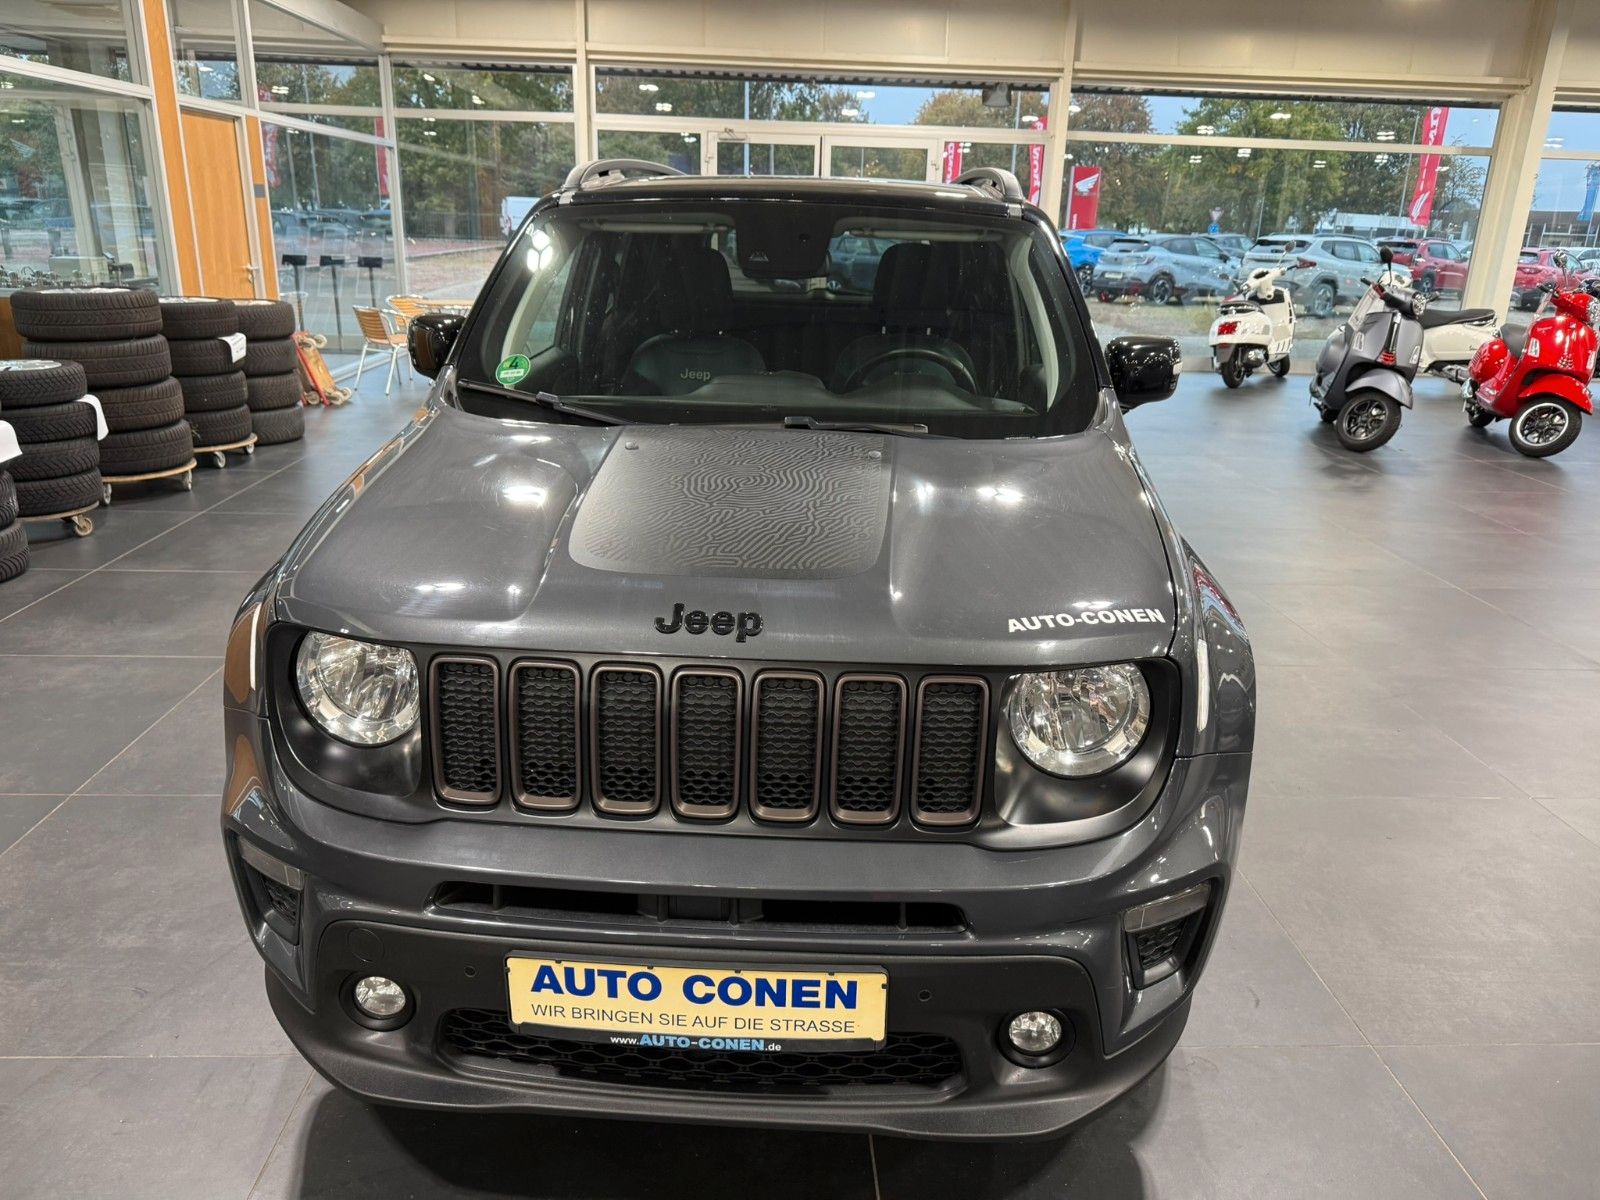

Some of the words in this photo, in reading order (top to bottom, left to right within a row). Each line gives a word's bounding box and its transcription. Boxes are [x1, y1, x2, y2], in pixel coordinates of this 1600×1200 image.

[508, 356, 519, 369] 4
[680, 368, 711, 381] Jeep
[654, 603, 763, 643] Jeep
[1008, 608, 1166, 633] AUTO-CONEN
[531, 964, 663, 1002] AUTO
[683, 975, 858, 1010] CONEN
[531, 1004, 566, 1018] WIR
[571, 1007, 653, 1025] BRINGEN
[658, 1013, 688, 1027] SIE
[692, 1015, 728, 1029] AUF
[734, 1017, 764, 1031] DIE
[770, 1018, 856, 1033] STRASSE
[609, 1034, 782, 1052] www.AUTO-CONEN.de
